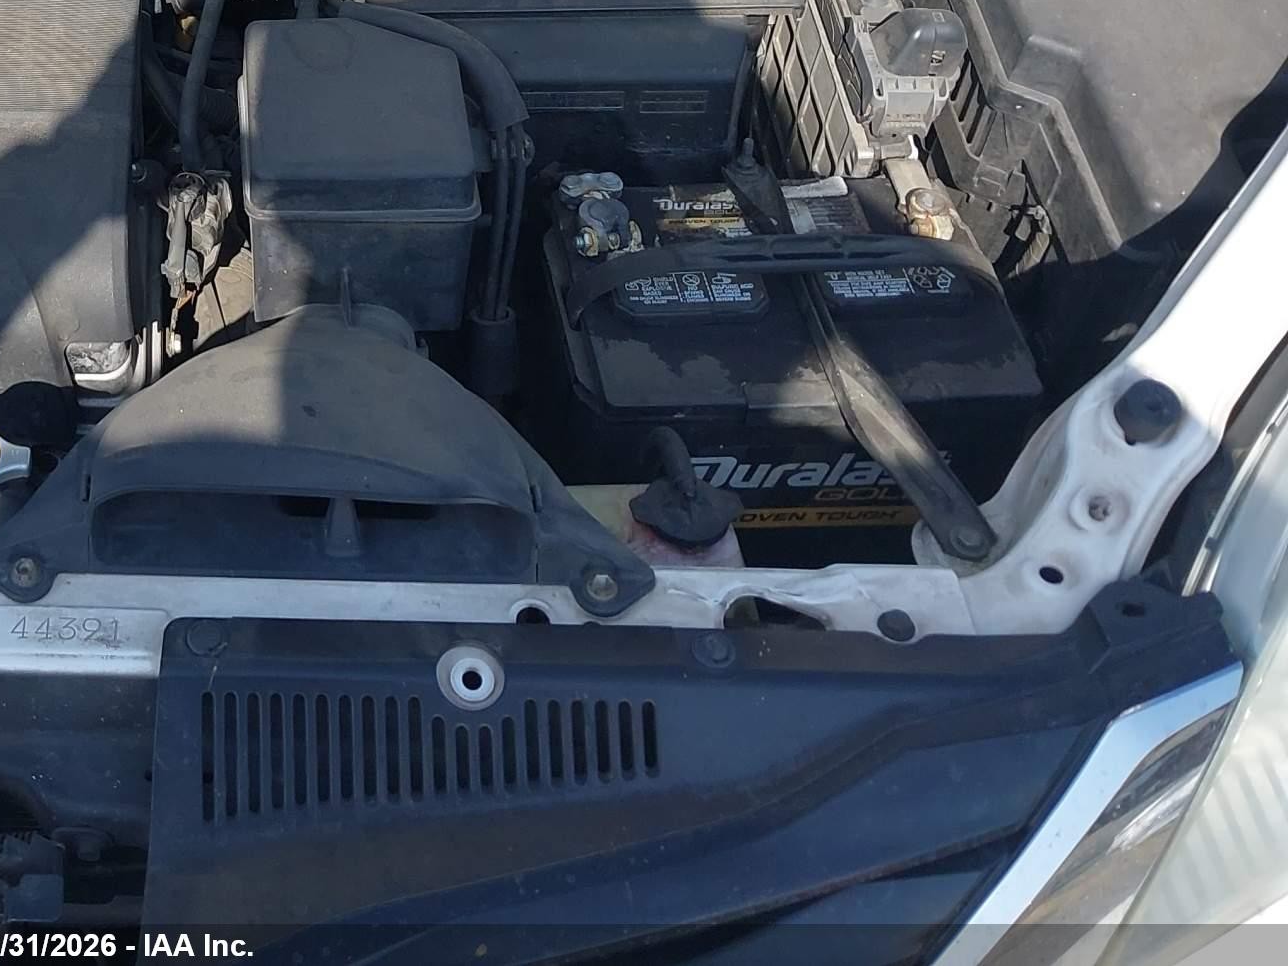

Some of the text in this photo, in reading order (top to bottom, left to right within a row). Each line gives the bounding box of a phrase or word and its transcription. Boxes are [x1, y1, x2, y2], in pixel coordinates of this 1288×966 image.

[652, 198, 740, 211] Duralas
[690, 452, 952, 488] Durala
[815, 487, 905, 501] GOL
[733, 511, 807, 524] OVEN
[9, 615, 121, 646] 44391
